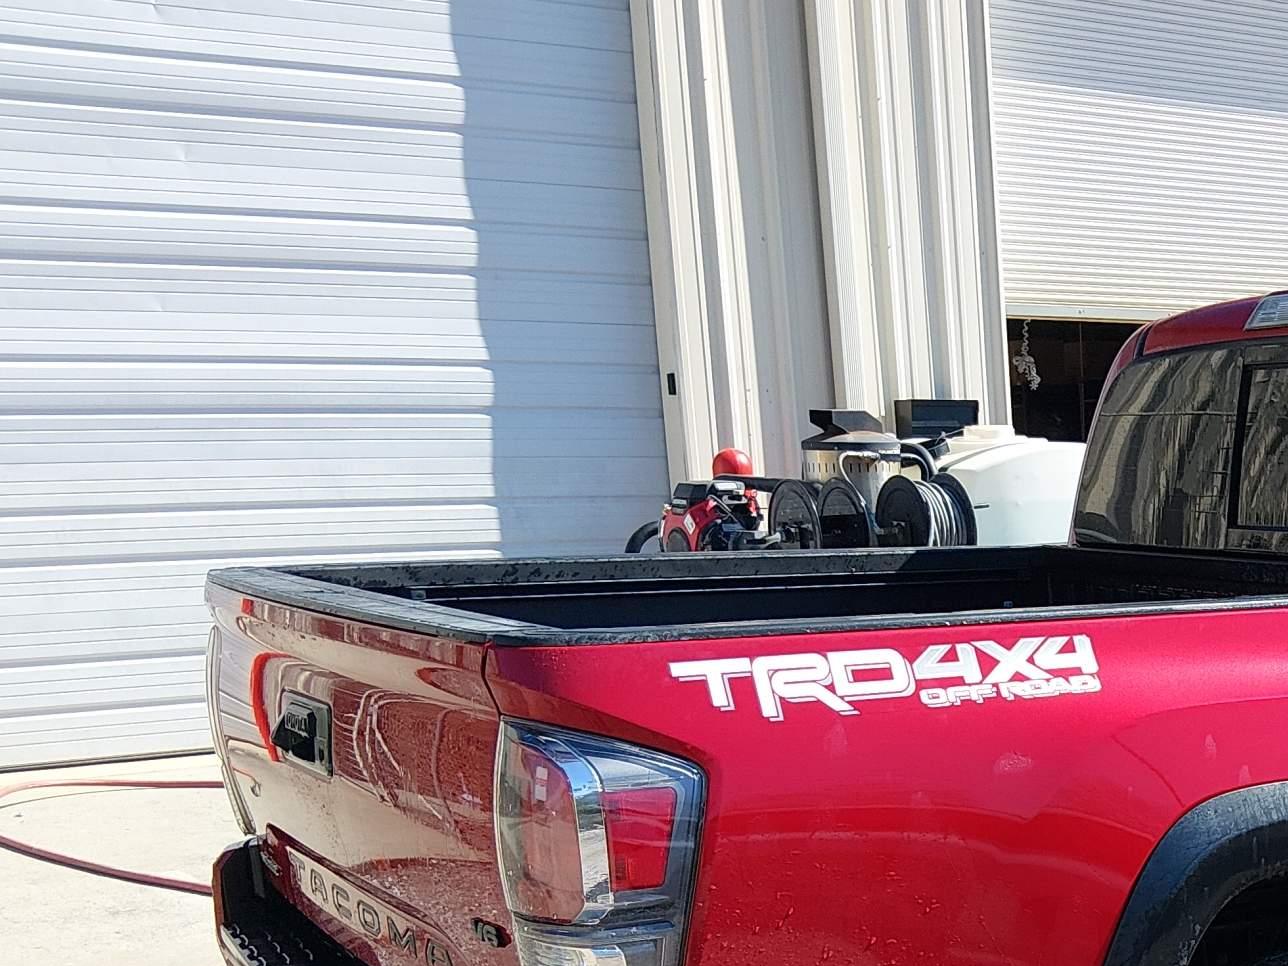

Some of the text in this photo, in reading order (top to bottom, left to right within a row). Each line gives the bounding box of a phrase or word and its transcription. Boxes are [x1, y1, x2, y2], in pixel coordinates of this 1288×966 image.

[668, 647, 916, 722] TRD
[919, 673, 1102, 708] OFF ROAD
